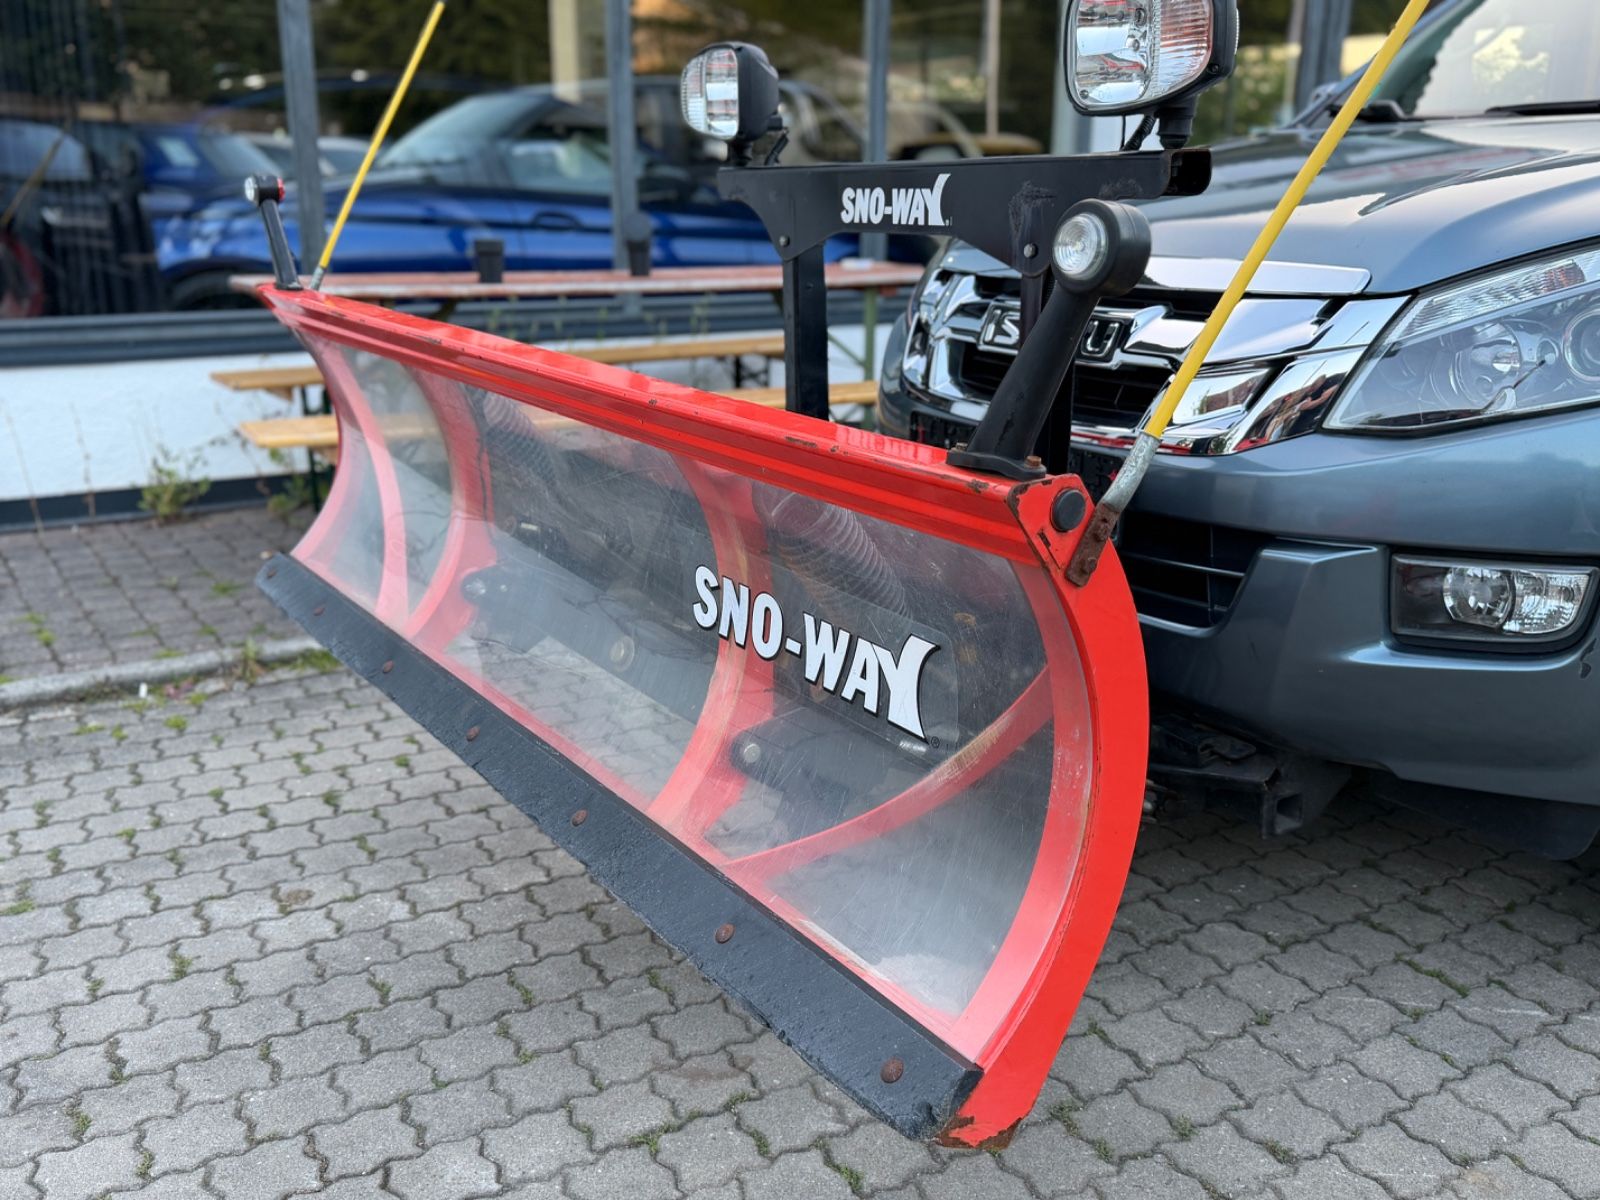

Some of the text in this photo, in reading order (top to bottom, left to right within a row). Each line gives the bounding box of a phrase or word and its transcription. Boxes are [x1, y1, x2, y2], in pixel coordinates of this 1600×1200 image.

[840, 173, 951, 226] SNO-WAY
[984, 309, 1120, 357] ISU
[693, 565, 939, 745] SNO-WAY
